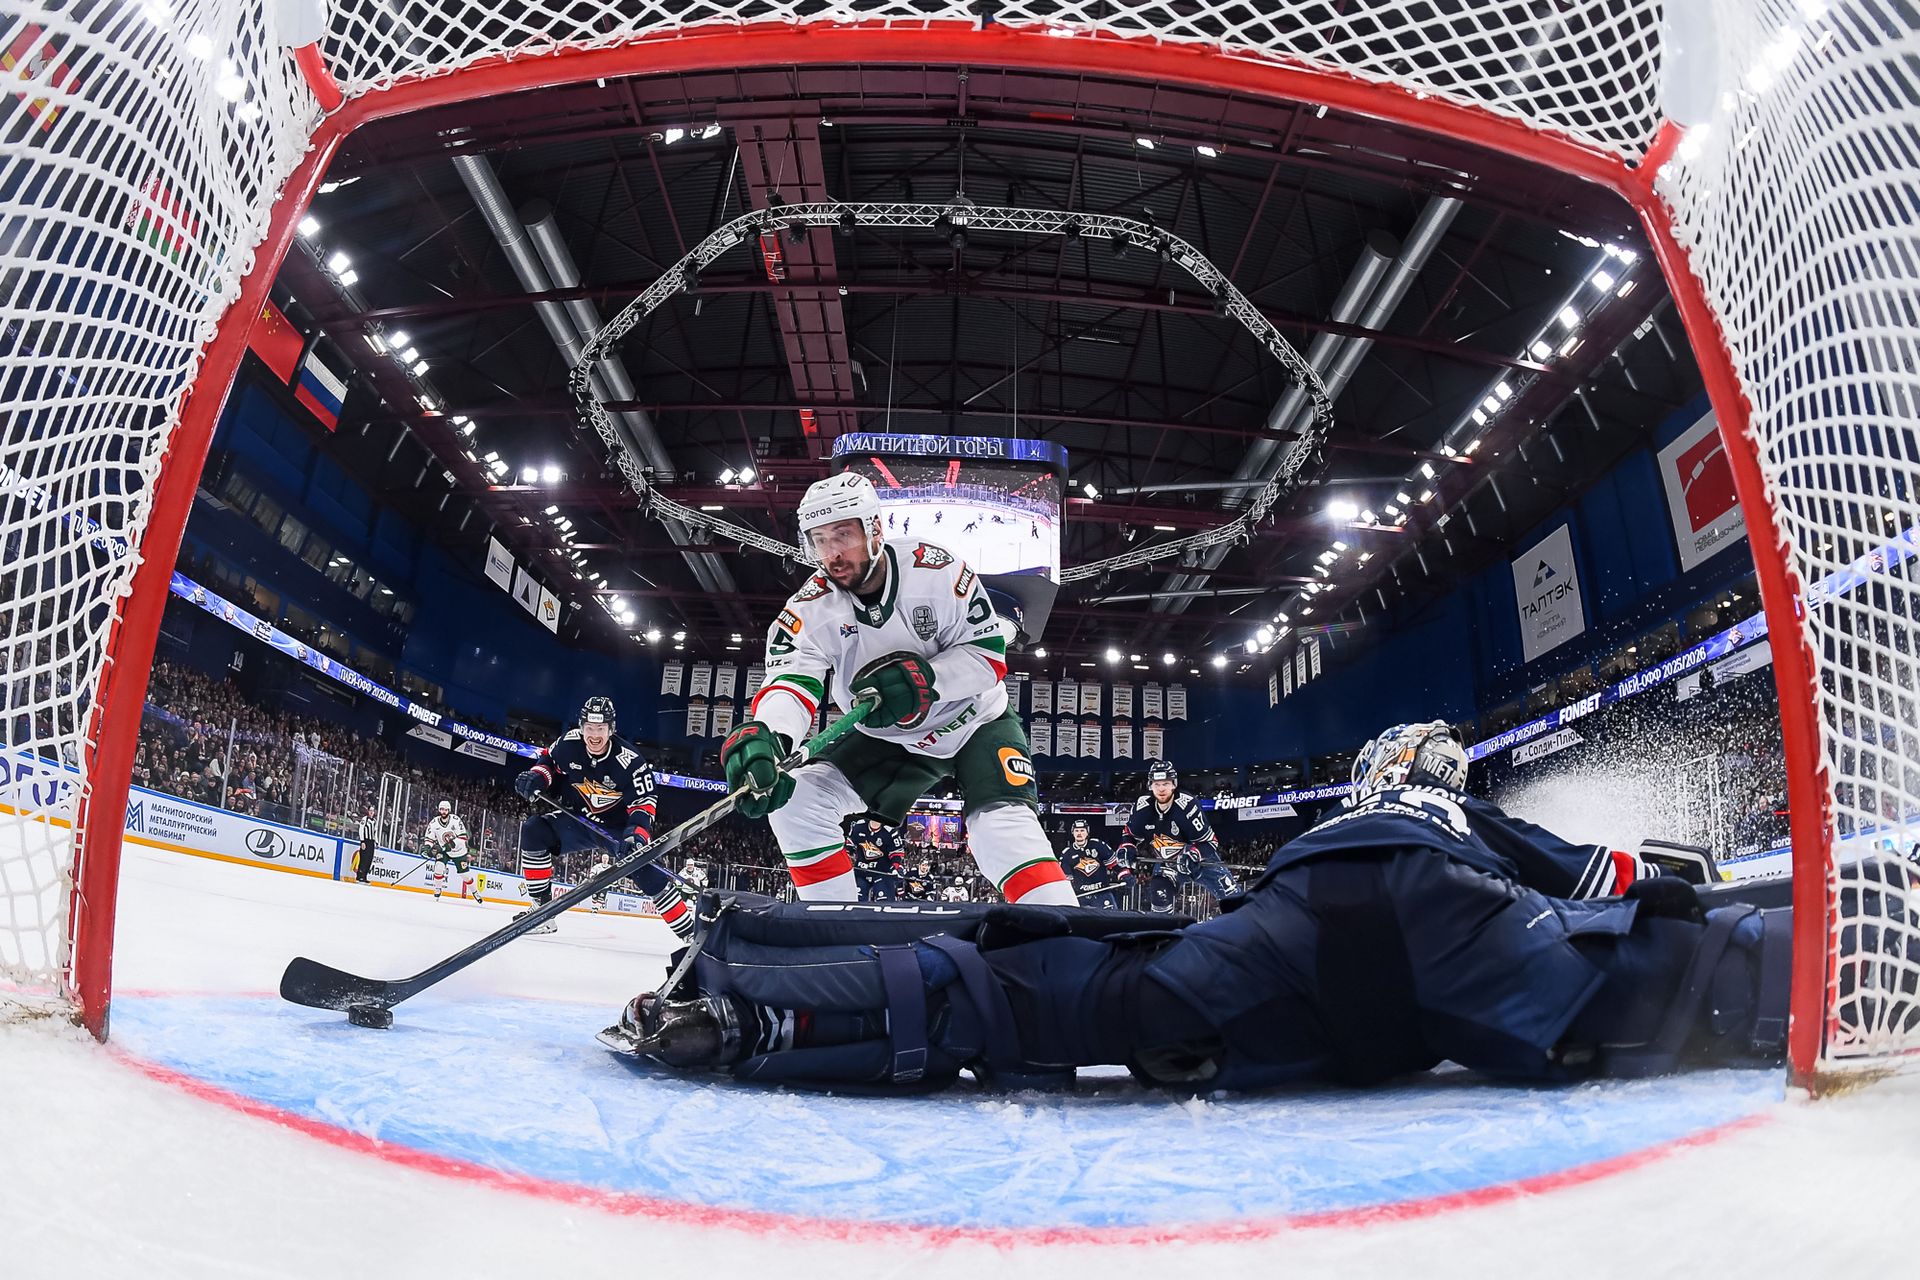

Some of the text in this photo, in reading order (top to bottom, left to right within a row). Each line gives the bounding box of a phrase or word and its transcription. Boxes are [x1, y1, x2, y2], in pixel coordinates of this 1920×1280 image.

[849, 434, 950, 455] МАГНИТНОЙ
[955, 438, 1004, 457] ГОРЫ
[804, 506, 833, 521] согаз
[1522, 576, 1574, 621] ТАЛТЭК
[1618, 668, 1662, 699] ПЛЕЙ-ОФФ
[1662, 646, 1708, 681] 2025/2026
[407, 702, 442, 727] FONBET
[1558, 692, 1602, 726] FONBET
[1484, 733, 1516, 755] ПЛЕЙ-ОФФ
[632, 773, 655, 796] 56
[684, 779, 728, 793] ПЛЕЙ-ОФФ
[1277, 784, 1354, 804] ПЛЕЙ-ОФФ 2025/2026
[150, 802, 213, 826] МАГНИТОГОРСКИЙ
[1214, 795, 1261, 811] FONBET
[149, 814, 217, 838] МЕТАЛЛУРГИЧЕСКИЙ
[1192, 810, 1205, 832] 87
[148, 826, 186, 842] КОМБИНАТ
[288, 840, 325, 864] LADA
[486, 879, 503, 891] БАНК
